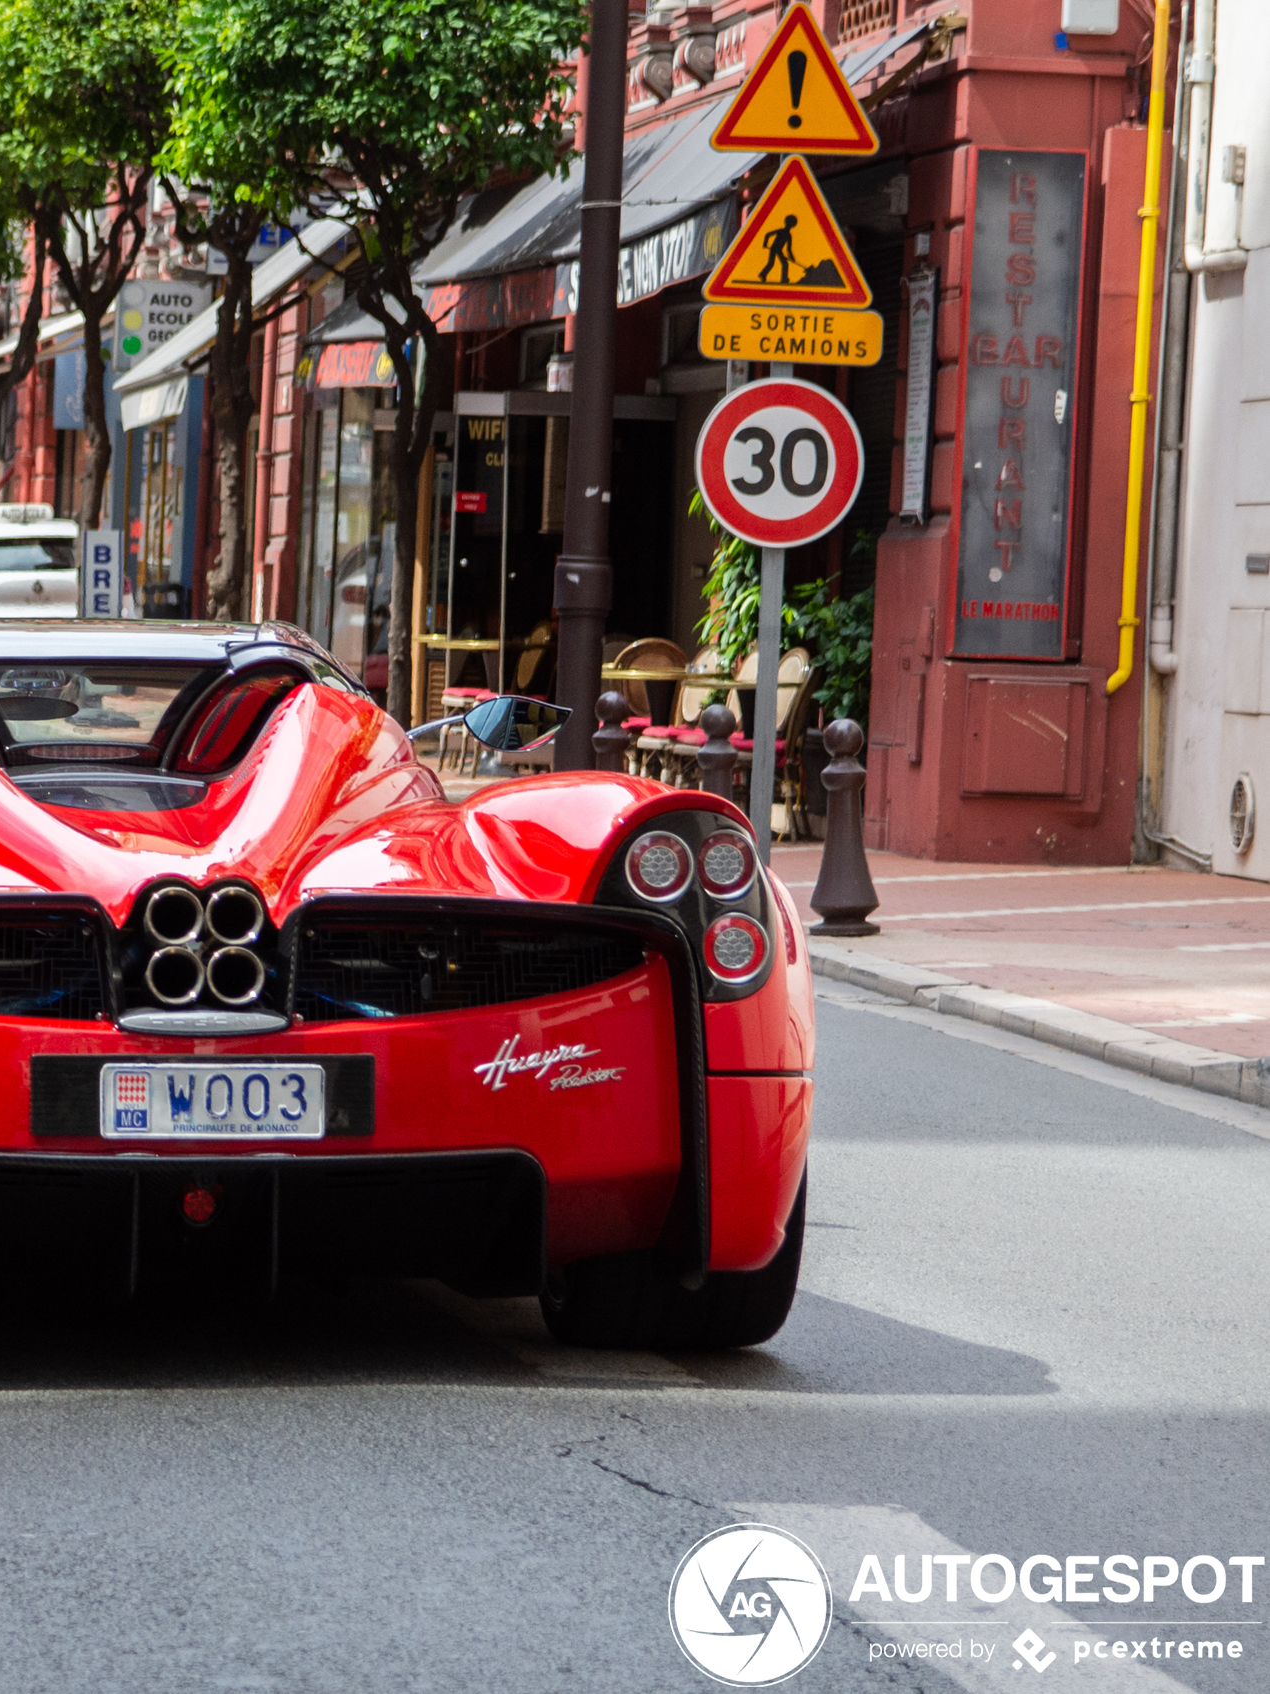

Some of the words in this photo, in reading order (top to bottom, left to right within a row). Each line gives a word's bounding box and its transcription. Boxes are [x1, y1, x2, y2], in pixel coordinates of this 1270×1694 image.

[633, 234, 661, 299] NON
[660, 217, 696, 287] STOP
[150, 293, 193, 308] AUTO
[750, 313, 834, 334] SORTIE
[713, 334, 741, 352] DE
[759, 336, 867, 359] CAMIONS
[970, 333, 1062, 370] BAR
[731, 426, 829, 497] 30
[962, 600, 978, 618] LE
[981, 600, 1059, 622] MARATHON
[473, 1033, 602, 1092] Huayra
[167, 1072, 308, 1122] W003
[121, 1111, 143, 1127] MC
[173, 1124, 236, 1132] PRINCIPAUTE
[240, 1124, 254, 1132] DE
[257, 1124, 299, 1132] MONACO
